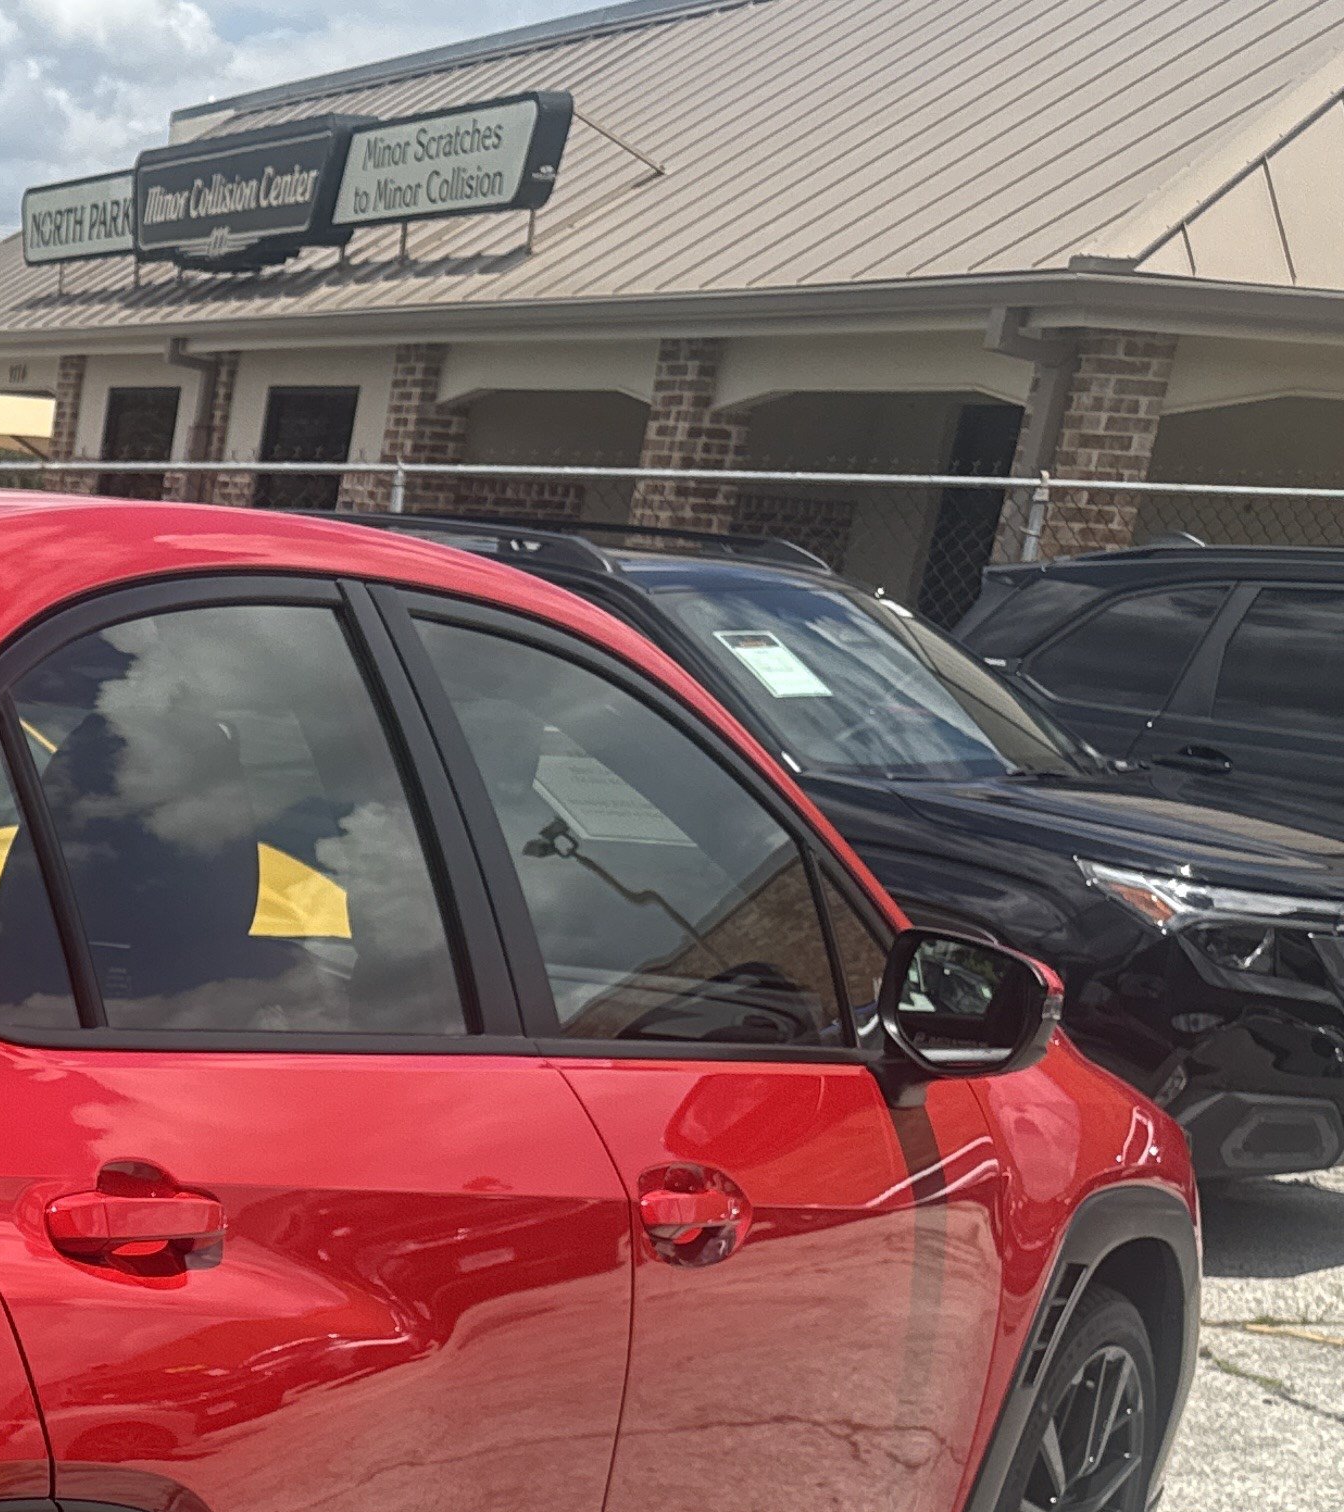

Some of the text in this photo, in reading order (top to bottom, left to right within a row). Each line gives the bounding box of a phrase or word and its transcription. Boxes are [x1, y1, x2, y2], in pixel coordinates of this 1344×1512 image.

[362, 119, 505, 171] Minor Scratches
[143, 163, 320, 225] Minor Collision Center
[353, 186, 370, 214] to
[372, 178, 422, 213] Minor
[426, 165, 504, 204] Collision
[30, 198, 133, 249] NORTH PARK
